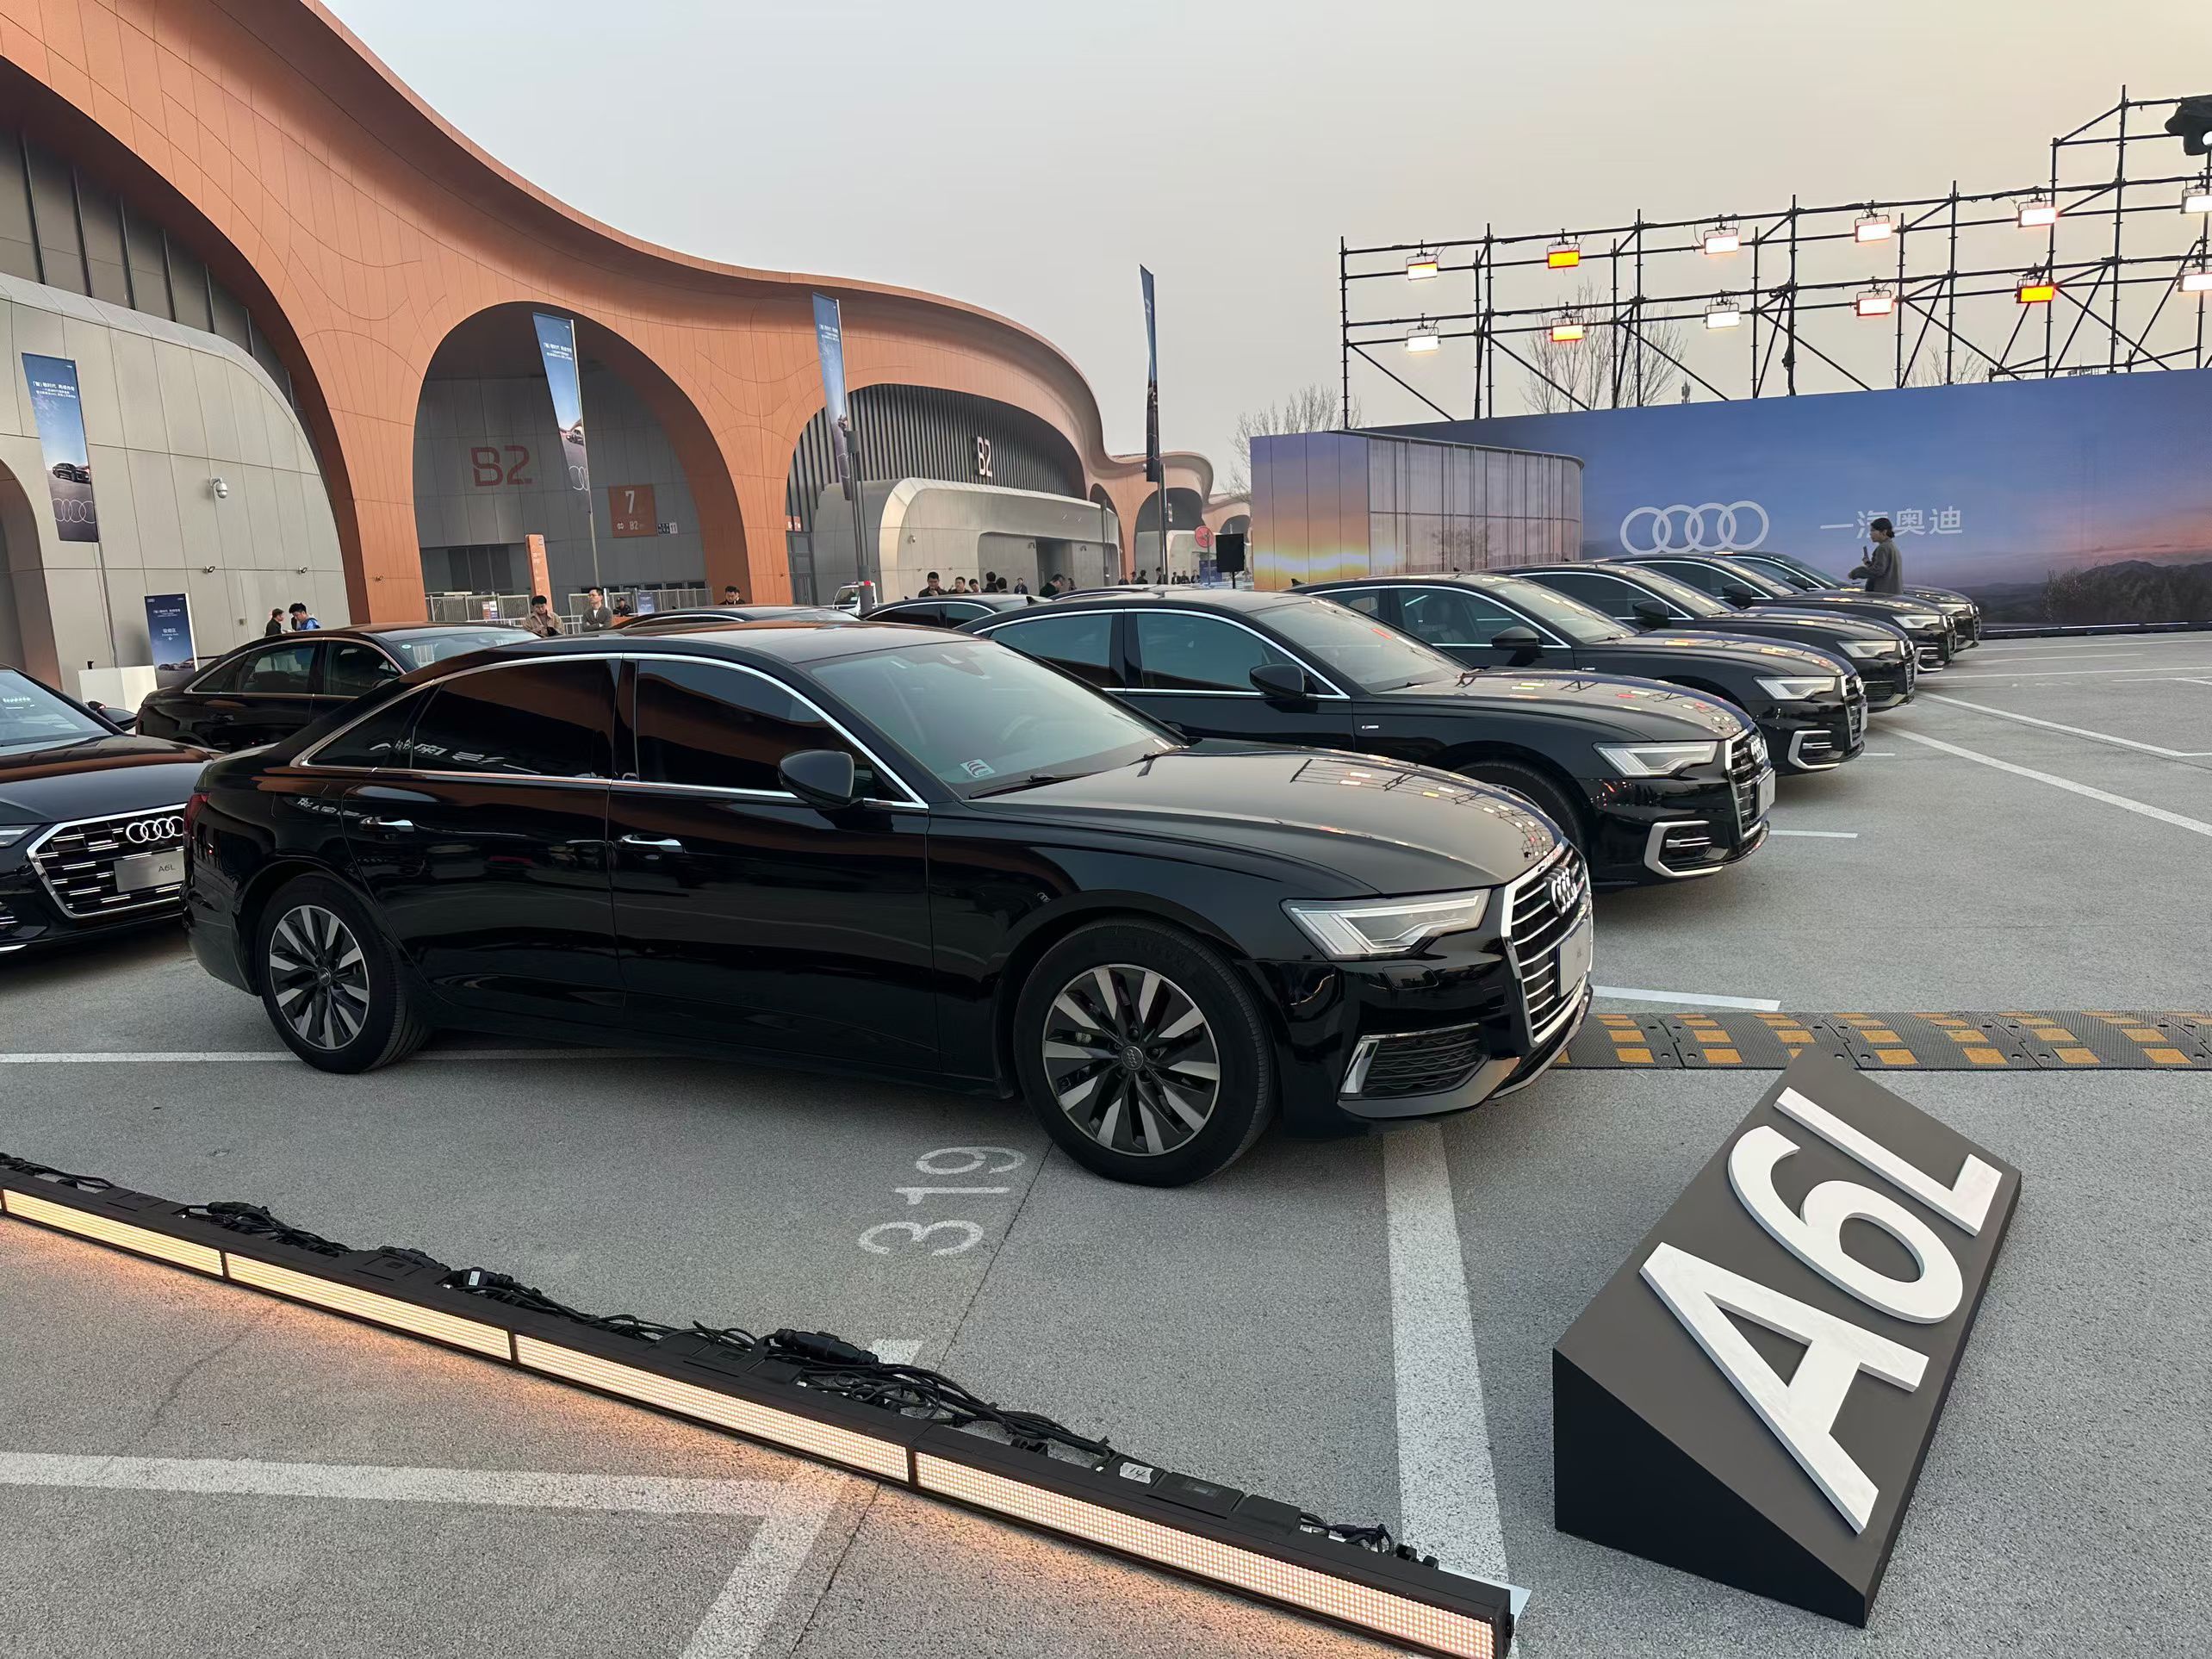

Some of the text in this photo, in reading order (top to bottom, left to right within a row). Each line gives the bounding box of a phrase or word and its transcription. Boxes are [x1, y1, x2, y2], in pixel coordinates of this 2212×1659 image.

[470, 445, 532, 486] B2
[977, 436, 992, 477] B2
[624, 490, 635, 514] 7
[629, 521, 638, 531] B2
[158, 864, 176, 873] A6L
[858, 1146, 1028, 1257] 319
[1638, 1085, 2003, 1536] A6L
